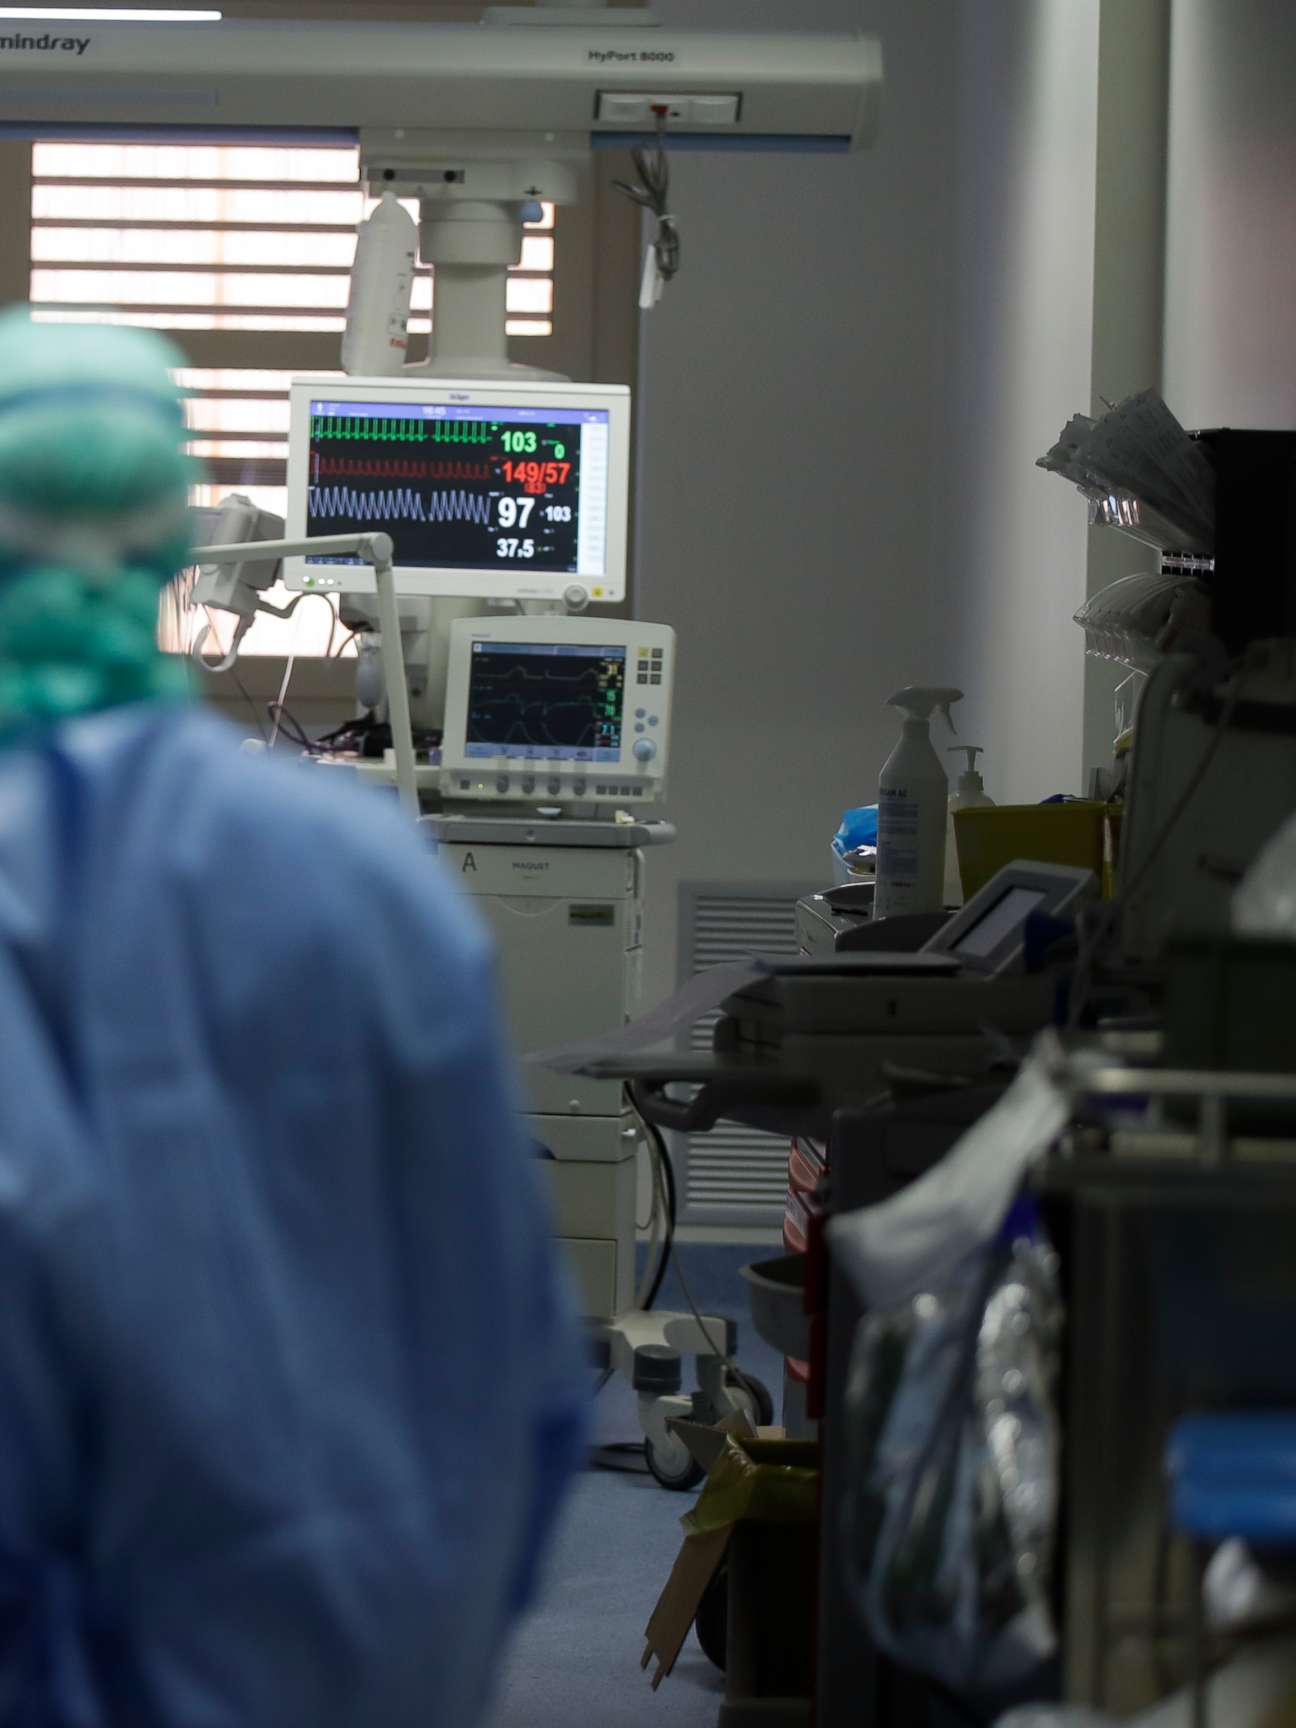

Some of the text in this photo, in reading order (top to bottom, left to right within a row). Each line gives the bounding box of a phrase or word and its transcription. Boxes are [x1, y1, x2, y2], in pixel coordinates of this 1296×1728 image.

[501, 431, 537, 453] 103
[554, 443, 565, 459] 0
[502, 461, 571, 484] 149/57
[497, 496, 535, 529] 97
[545, 505, 571, 522] 103
[462, 852, 478, 872] A
